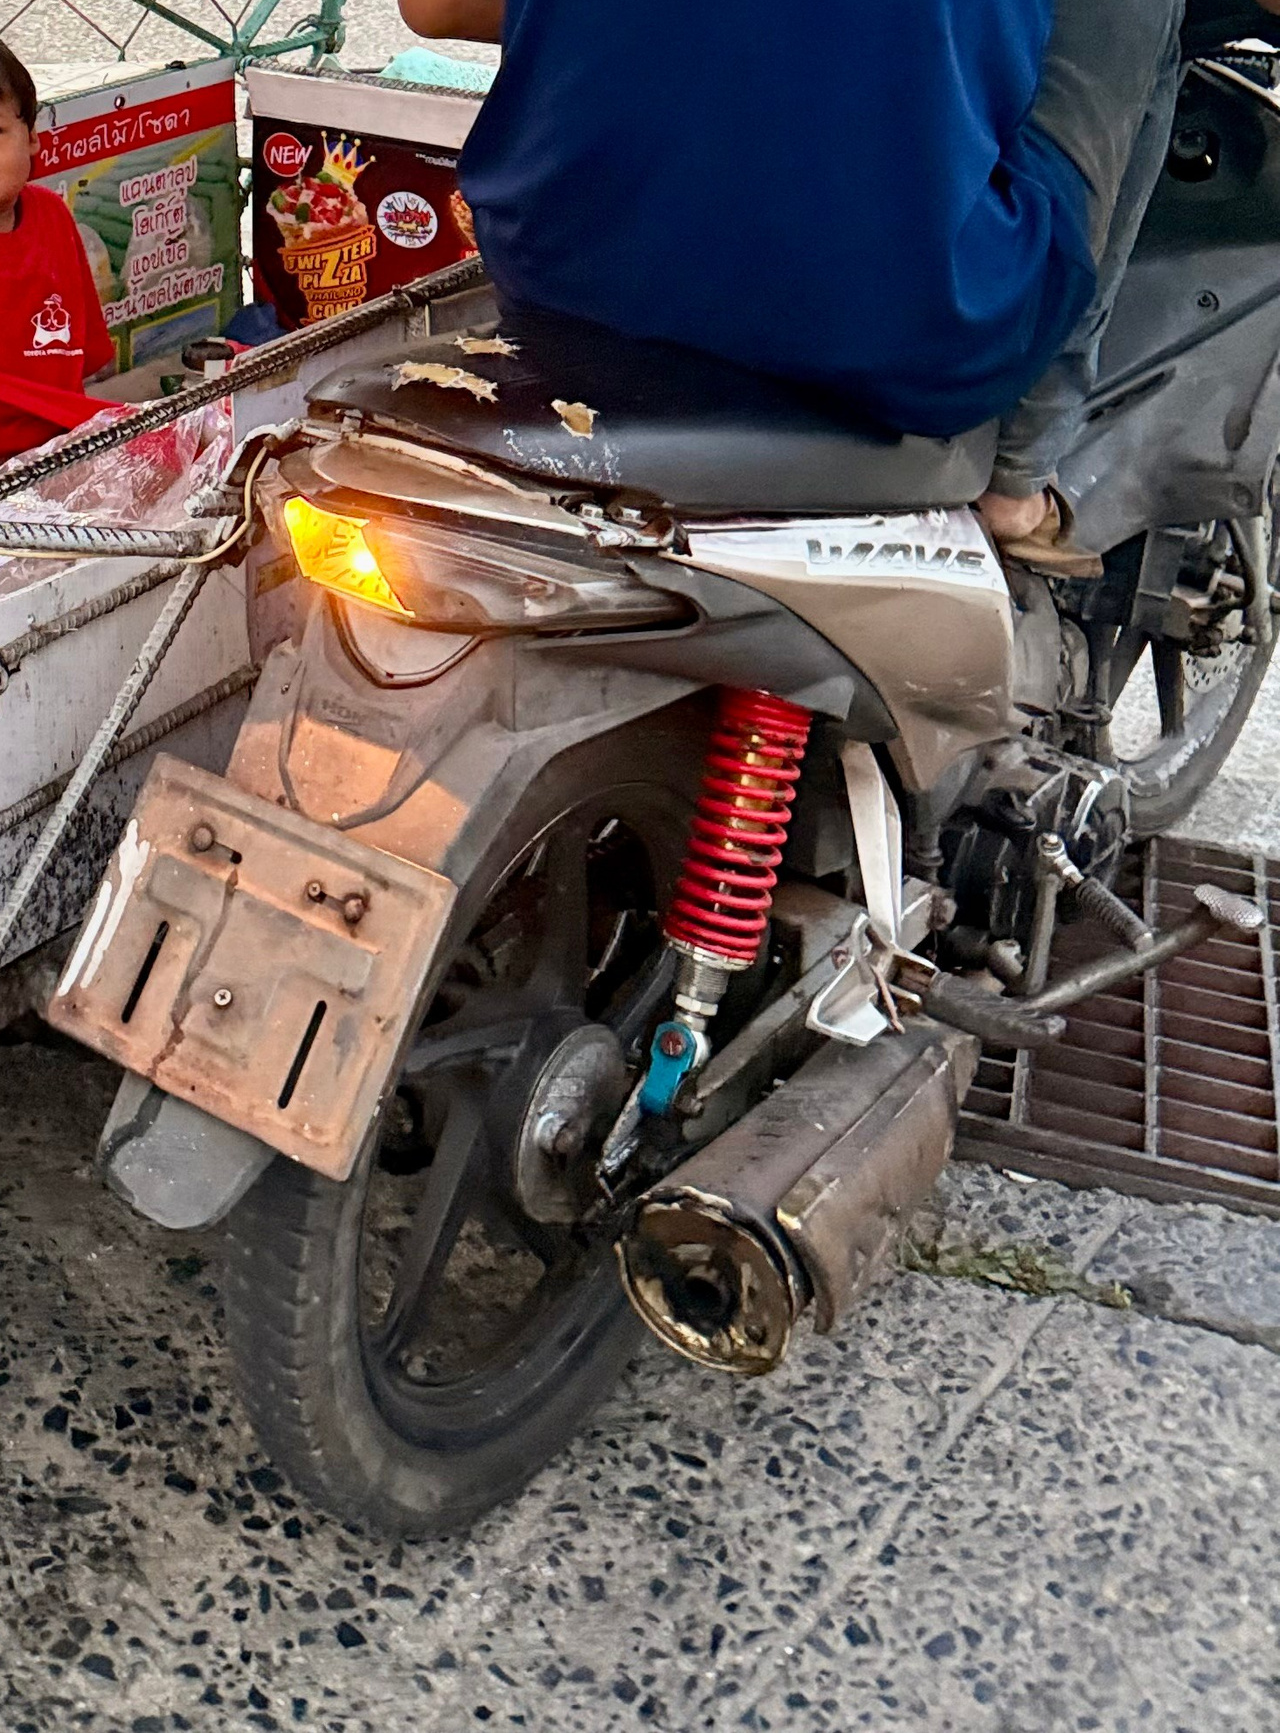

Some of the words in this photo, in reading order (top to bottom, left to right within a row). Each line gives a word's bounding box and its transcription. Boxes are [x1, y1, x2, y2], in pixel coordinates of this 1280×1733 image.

[40, 109, 190, 166] น้ำผลไม้/โซดา
[269, 144, 313, 165] NEW
[806, 539, 989, 576] WAVE
